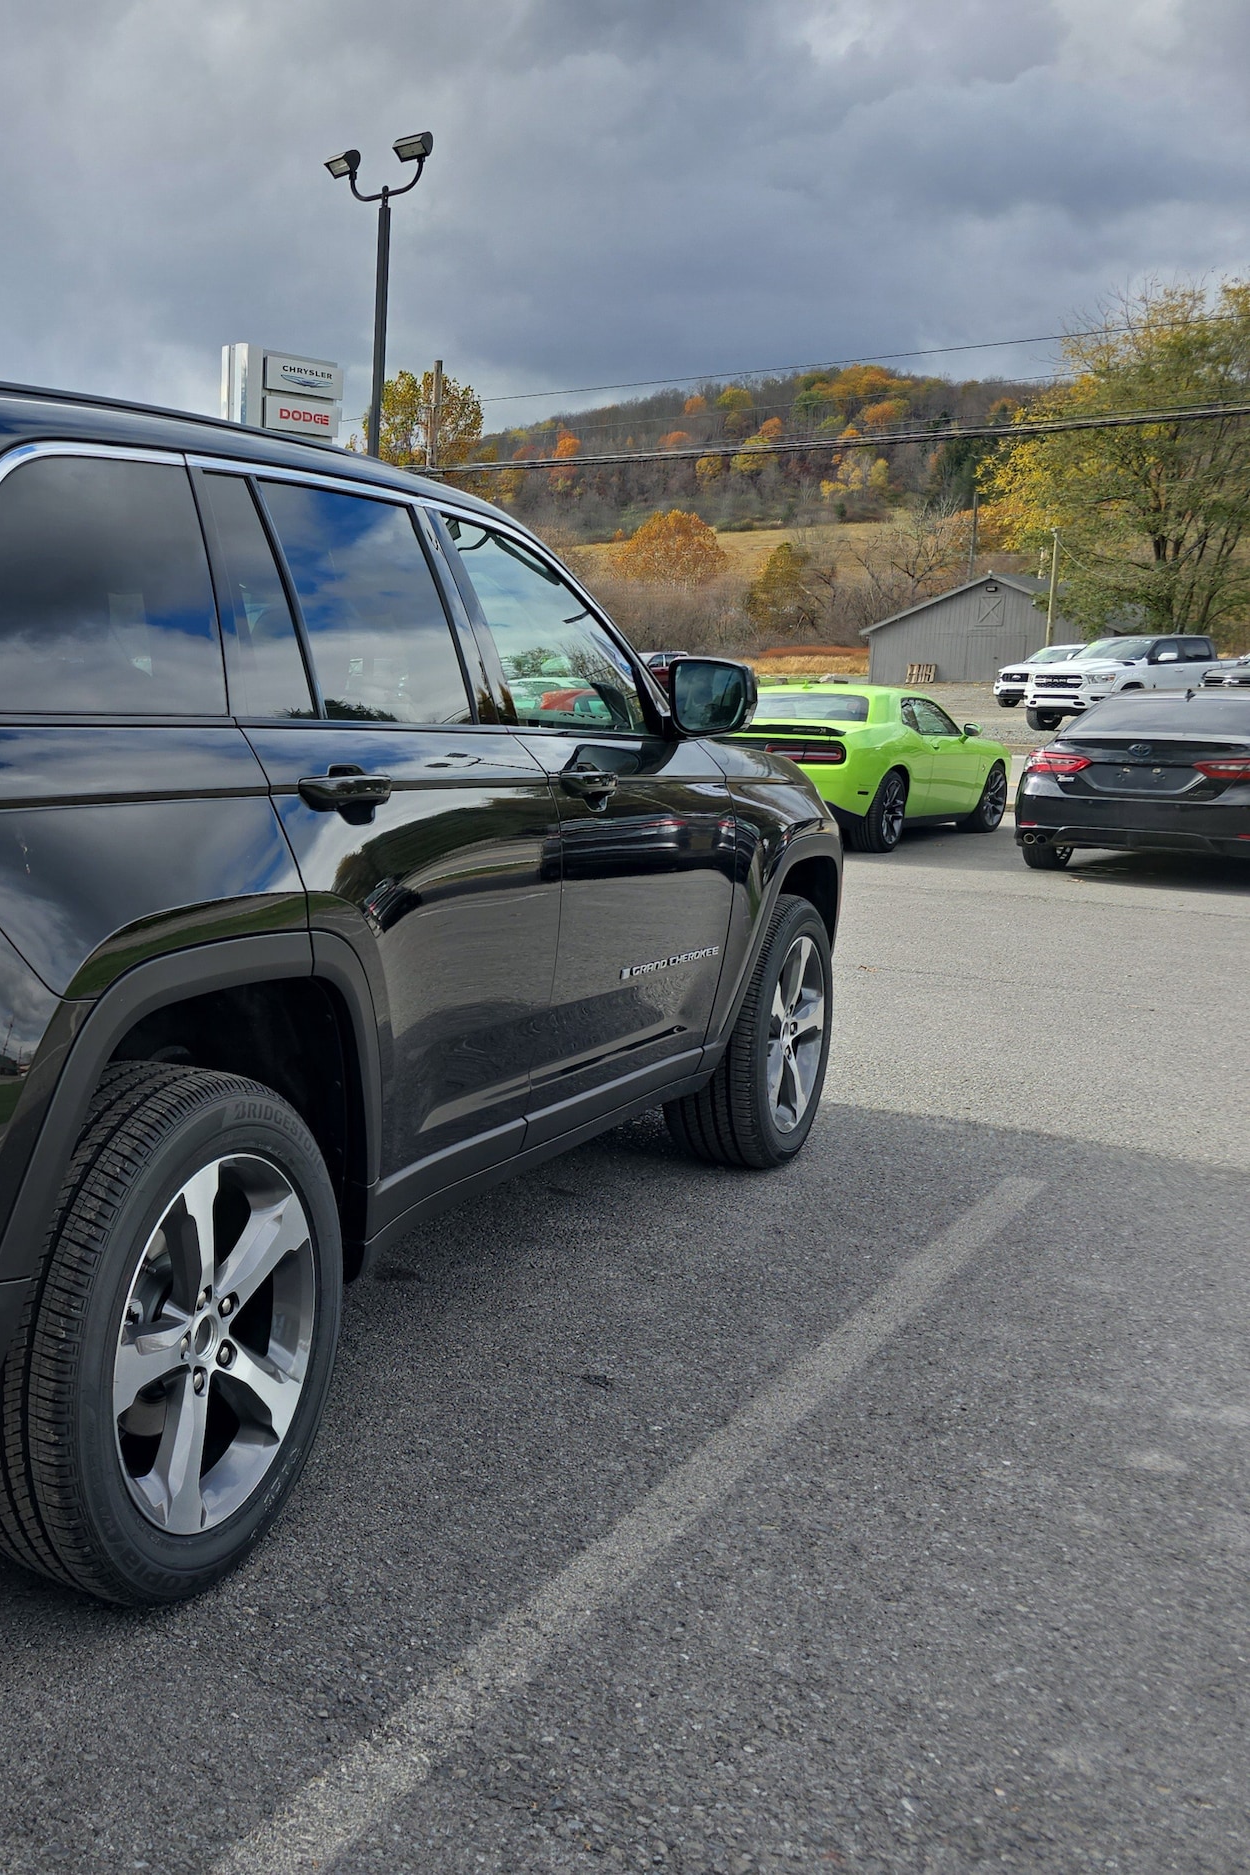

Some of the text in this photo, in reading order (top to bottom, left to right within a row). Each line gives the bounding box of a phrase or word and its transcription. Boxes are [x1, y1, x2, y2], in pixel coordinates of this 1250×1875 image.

[282, 365, 333, 380] CHRYSLER
[279, 408, 330, 426] DODGE
[632, 946, 720, 976] GRAND CHEROKEE
